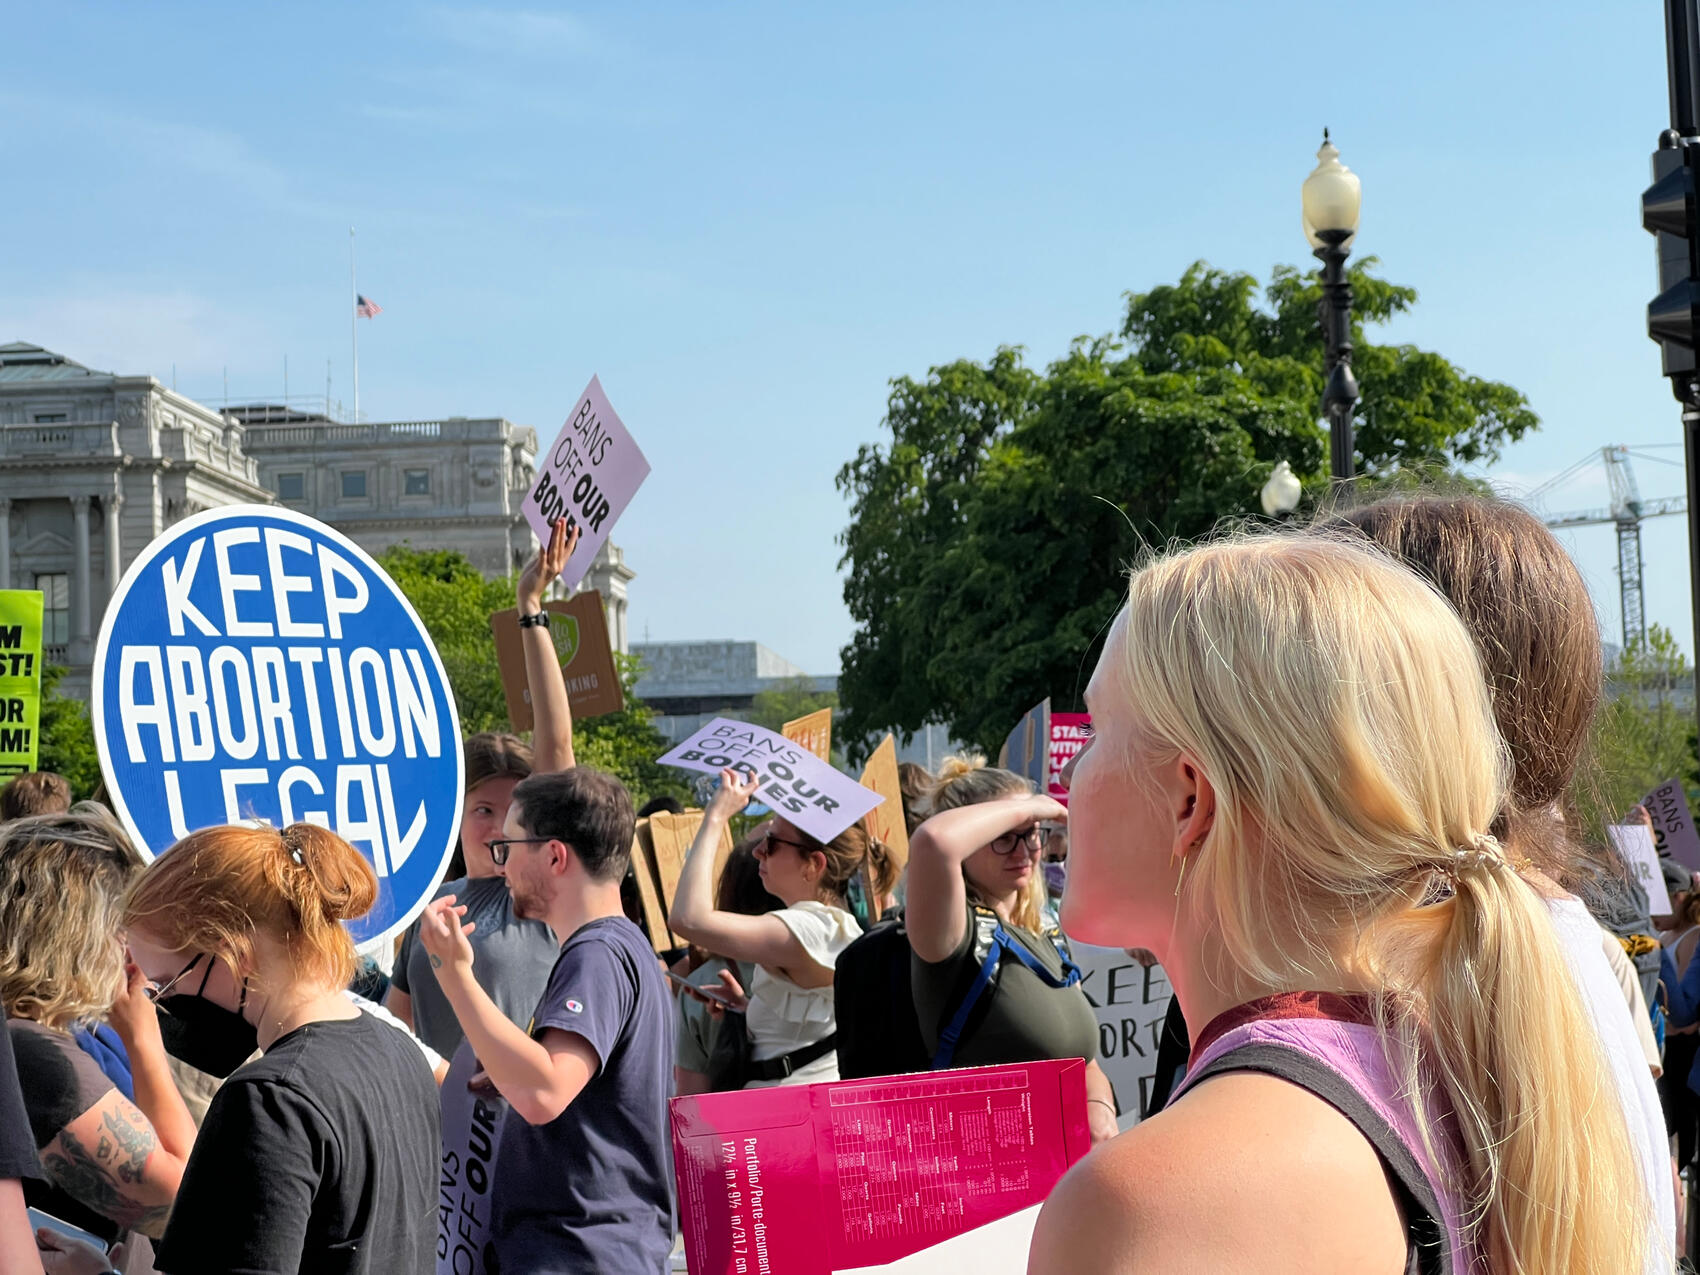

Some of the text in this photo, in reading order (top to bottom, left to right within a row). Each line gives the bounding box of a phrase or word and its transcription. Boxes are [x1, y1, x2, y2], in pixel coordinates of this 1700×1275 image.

[573, 399, 613, 467] BANS
[554, 437, 610, 534] OFF OUR
[162, 527, 370, 640] KEEP
[119, 645, 441, 763] ABORTION
[712, 725, 803, 765] BANS
[698, 738, 762, 758] OFF
[767, 761, 841, 814] OUR
[1657, 786, 1684, 833] BANS
[163, 764, 427, 877] LEGAL
[452, 1099, 496, 1275] OFF OUR
[735, 1257, 747, 1273] cm
